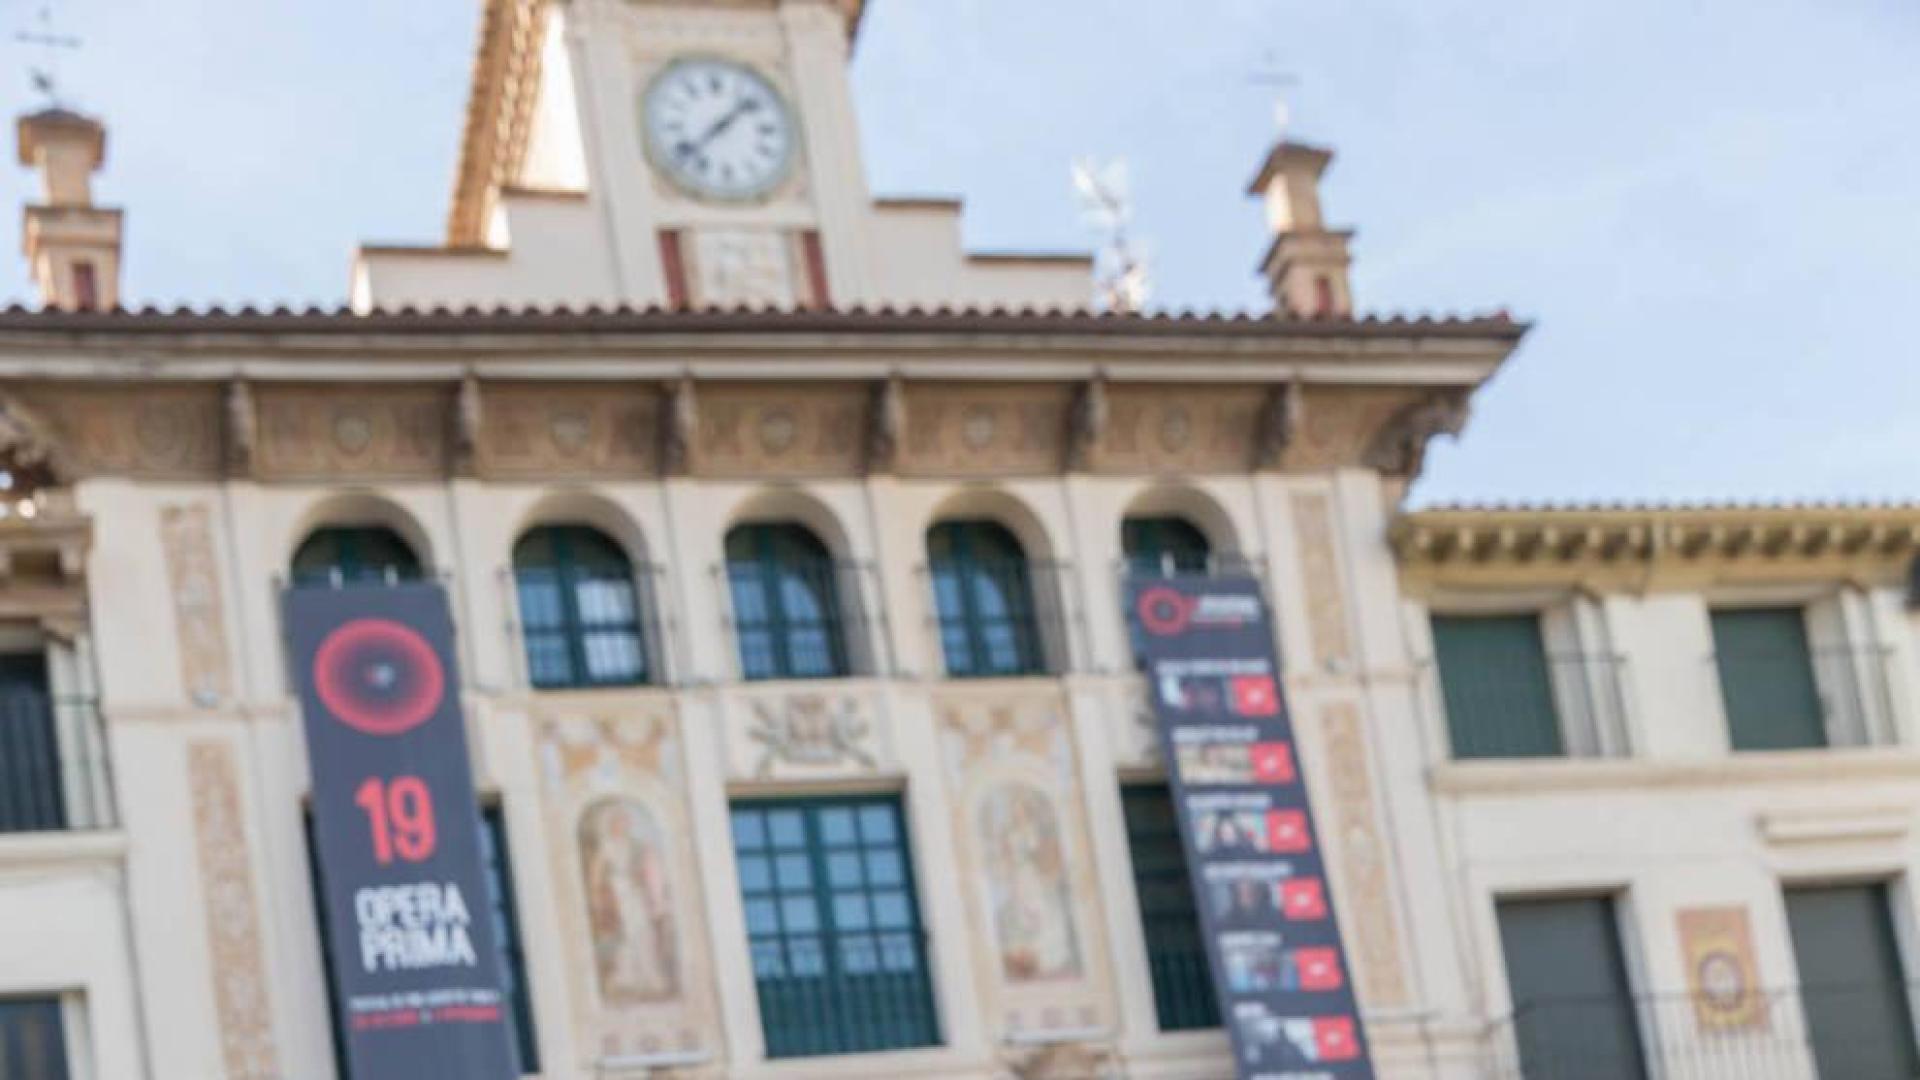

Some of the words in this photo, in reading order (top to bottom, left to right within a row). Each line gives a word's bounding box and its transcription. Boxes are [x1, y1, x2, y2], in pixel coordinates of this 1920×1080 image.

[356, 775, 436, 864] 19
[355, 882, 471, 930] OPERA
[360, 924, 477, 972] PRIMA
